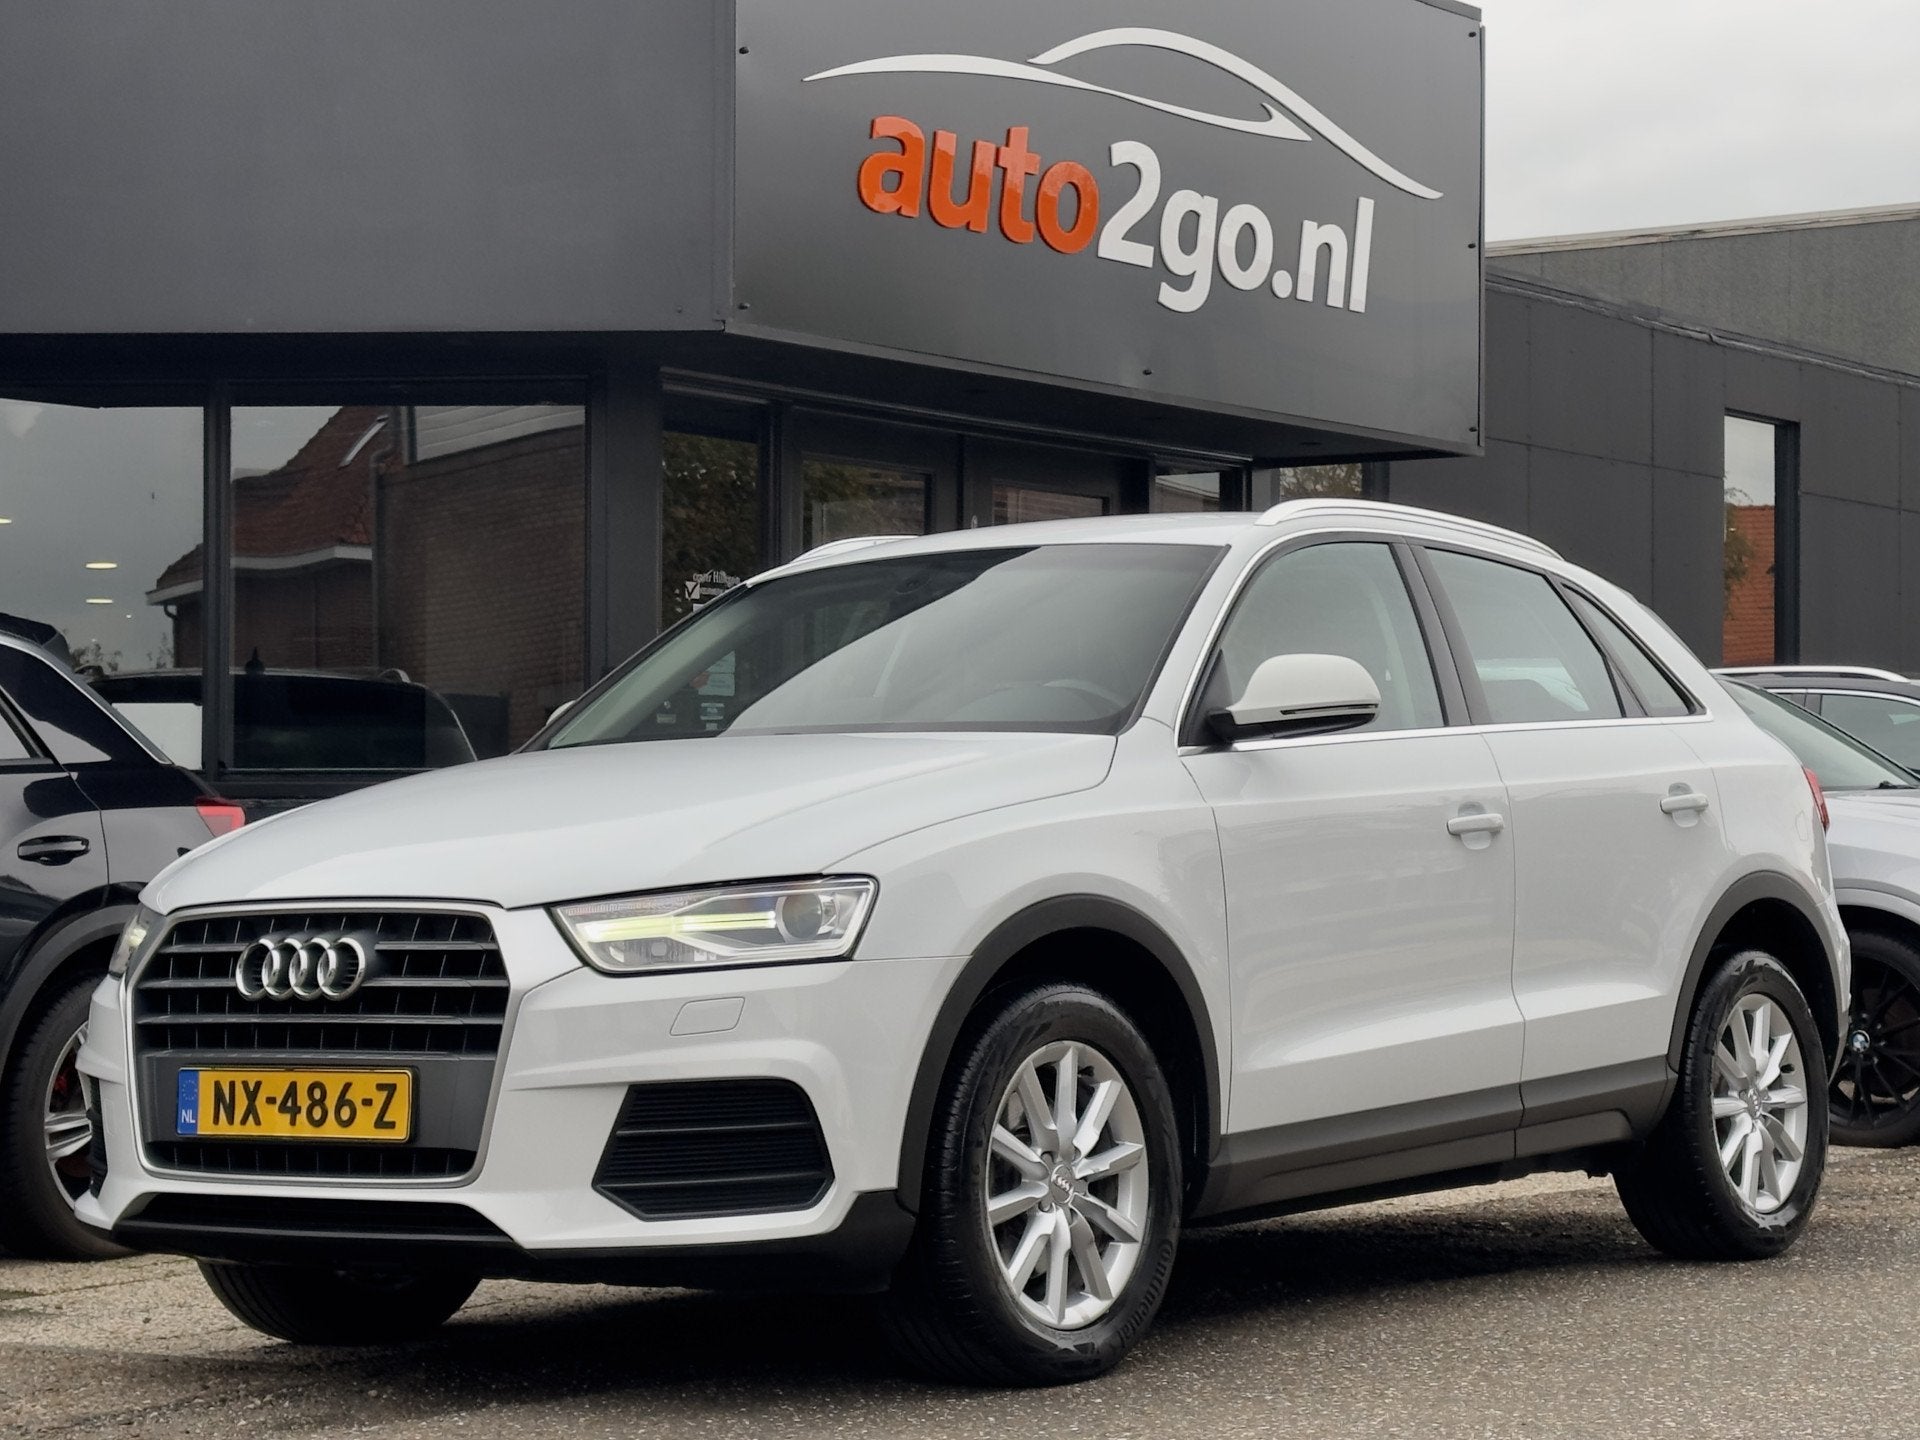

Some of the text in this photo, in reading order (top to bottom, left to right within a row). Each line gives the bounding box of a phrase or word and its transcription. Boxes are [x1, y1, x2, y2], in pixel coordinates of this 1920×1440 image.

[858, 115, 1375, 313] auto2go.nl
[181, 1108, 197, 1124] NL
[212, 1080, 398, 1130] NX-486-Z
